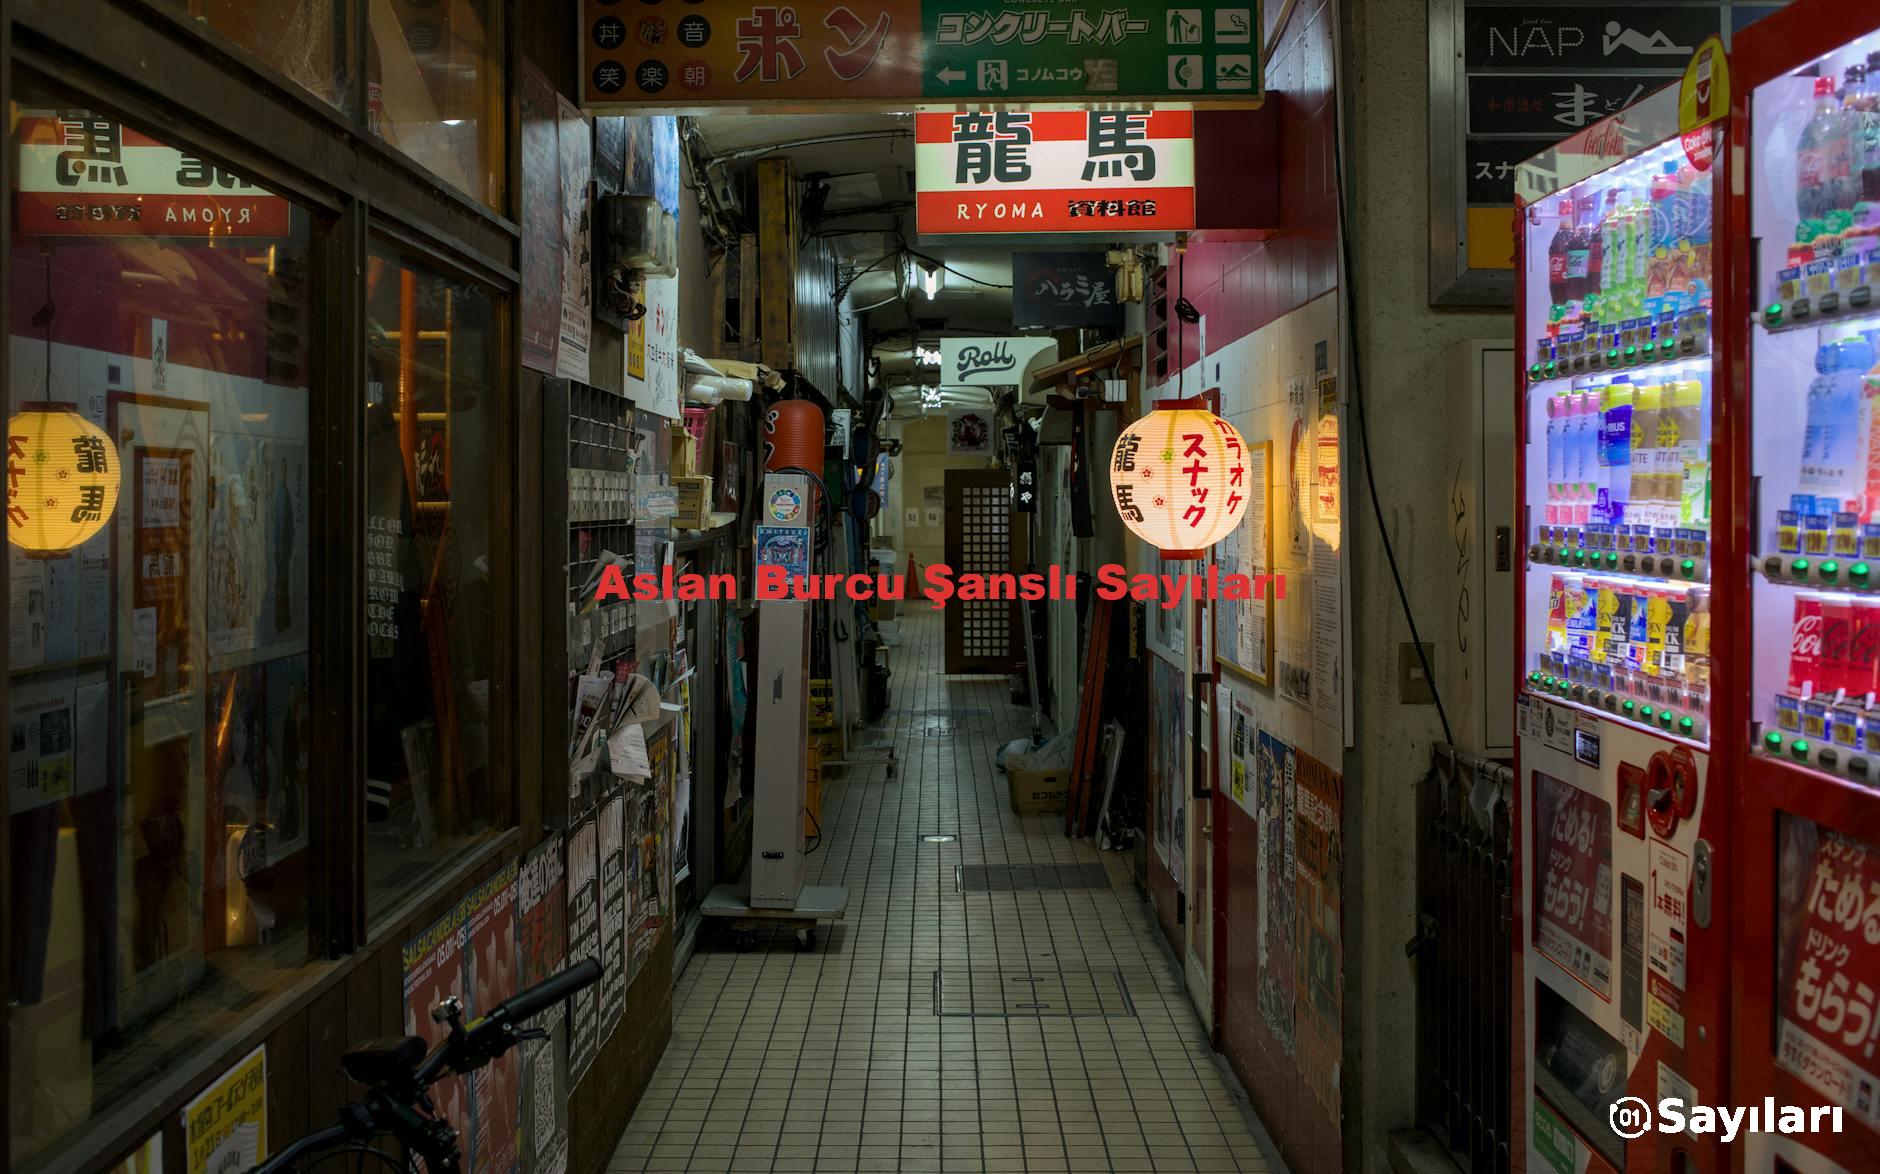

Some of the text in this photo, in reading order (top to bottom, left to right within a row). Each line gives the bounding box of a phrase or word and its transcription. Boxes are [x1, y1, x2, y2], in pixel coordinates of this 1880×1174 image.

[683, 22, 705, 42] 音
[733, 6, 891, 82] ポン
[936, 10, 1149, 46] コンクリートバー
[1489, 26, 1584, 56] NAP
[599, 68, 621, 88] 笑
[641, 68, 664, 88] 楽
[685, 66, 705, 87] 朝
[957, 203, 1044, 220] RYOMA
[1034, 274, 1110, 307] ハラミ屋
[957, 341, 1016, 377] Roll
[1182, 434, 1209, 528] スナック
[1214, 418, 1244, 514] カラオケ
[1805, 927, 1851, 968] ドリンク
